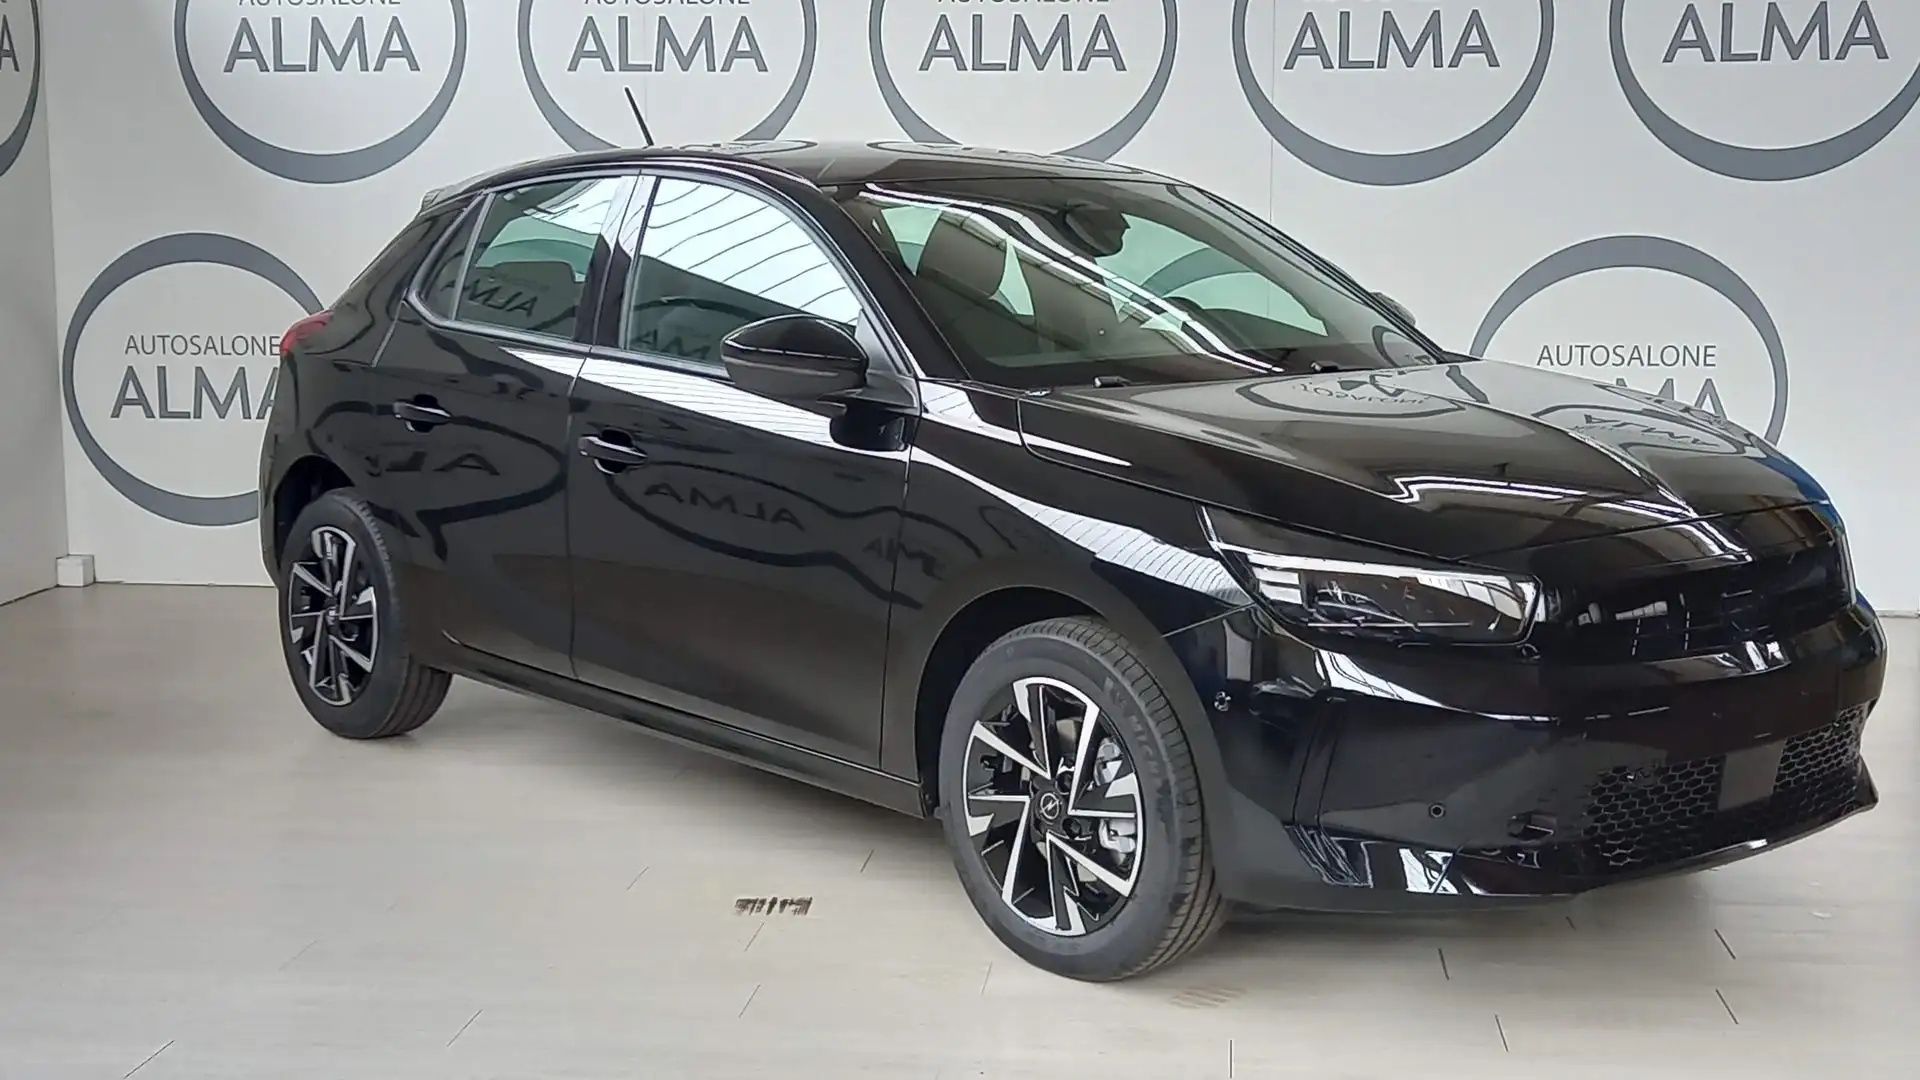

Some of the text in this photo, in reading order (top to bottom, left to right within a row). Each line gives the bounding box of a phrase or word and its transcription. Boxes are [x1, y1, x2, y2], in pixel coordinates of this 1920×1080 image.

[224, 16, 421, 73] ALMA
[568, 16, 769, 72] ALMA
[919, 14, 1127, 72] ALMA
[1283, 9, 1500, 70] ALMA
[1662, 0, 1889, 63] ALMA
[125, 335, 281, 356] AUTOSALONE
[1537, 345, 1717, 367] AUTOSALONE
